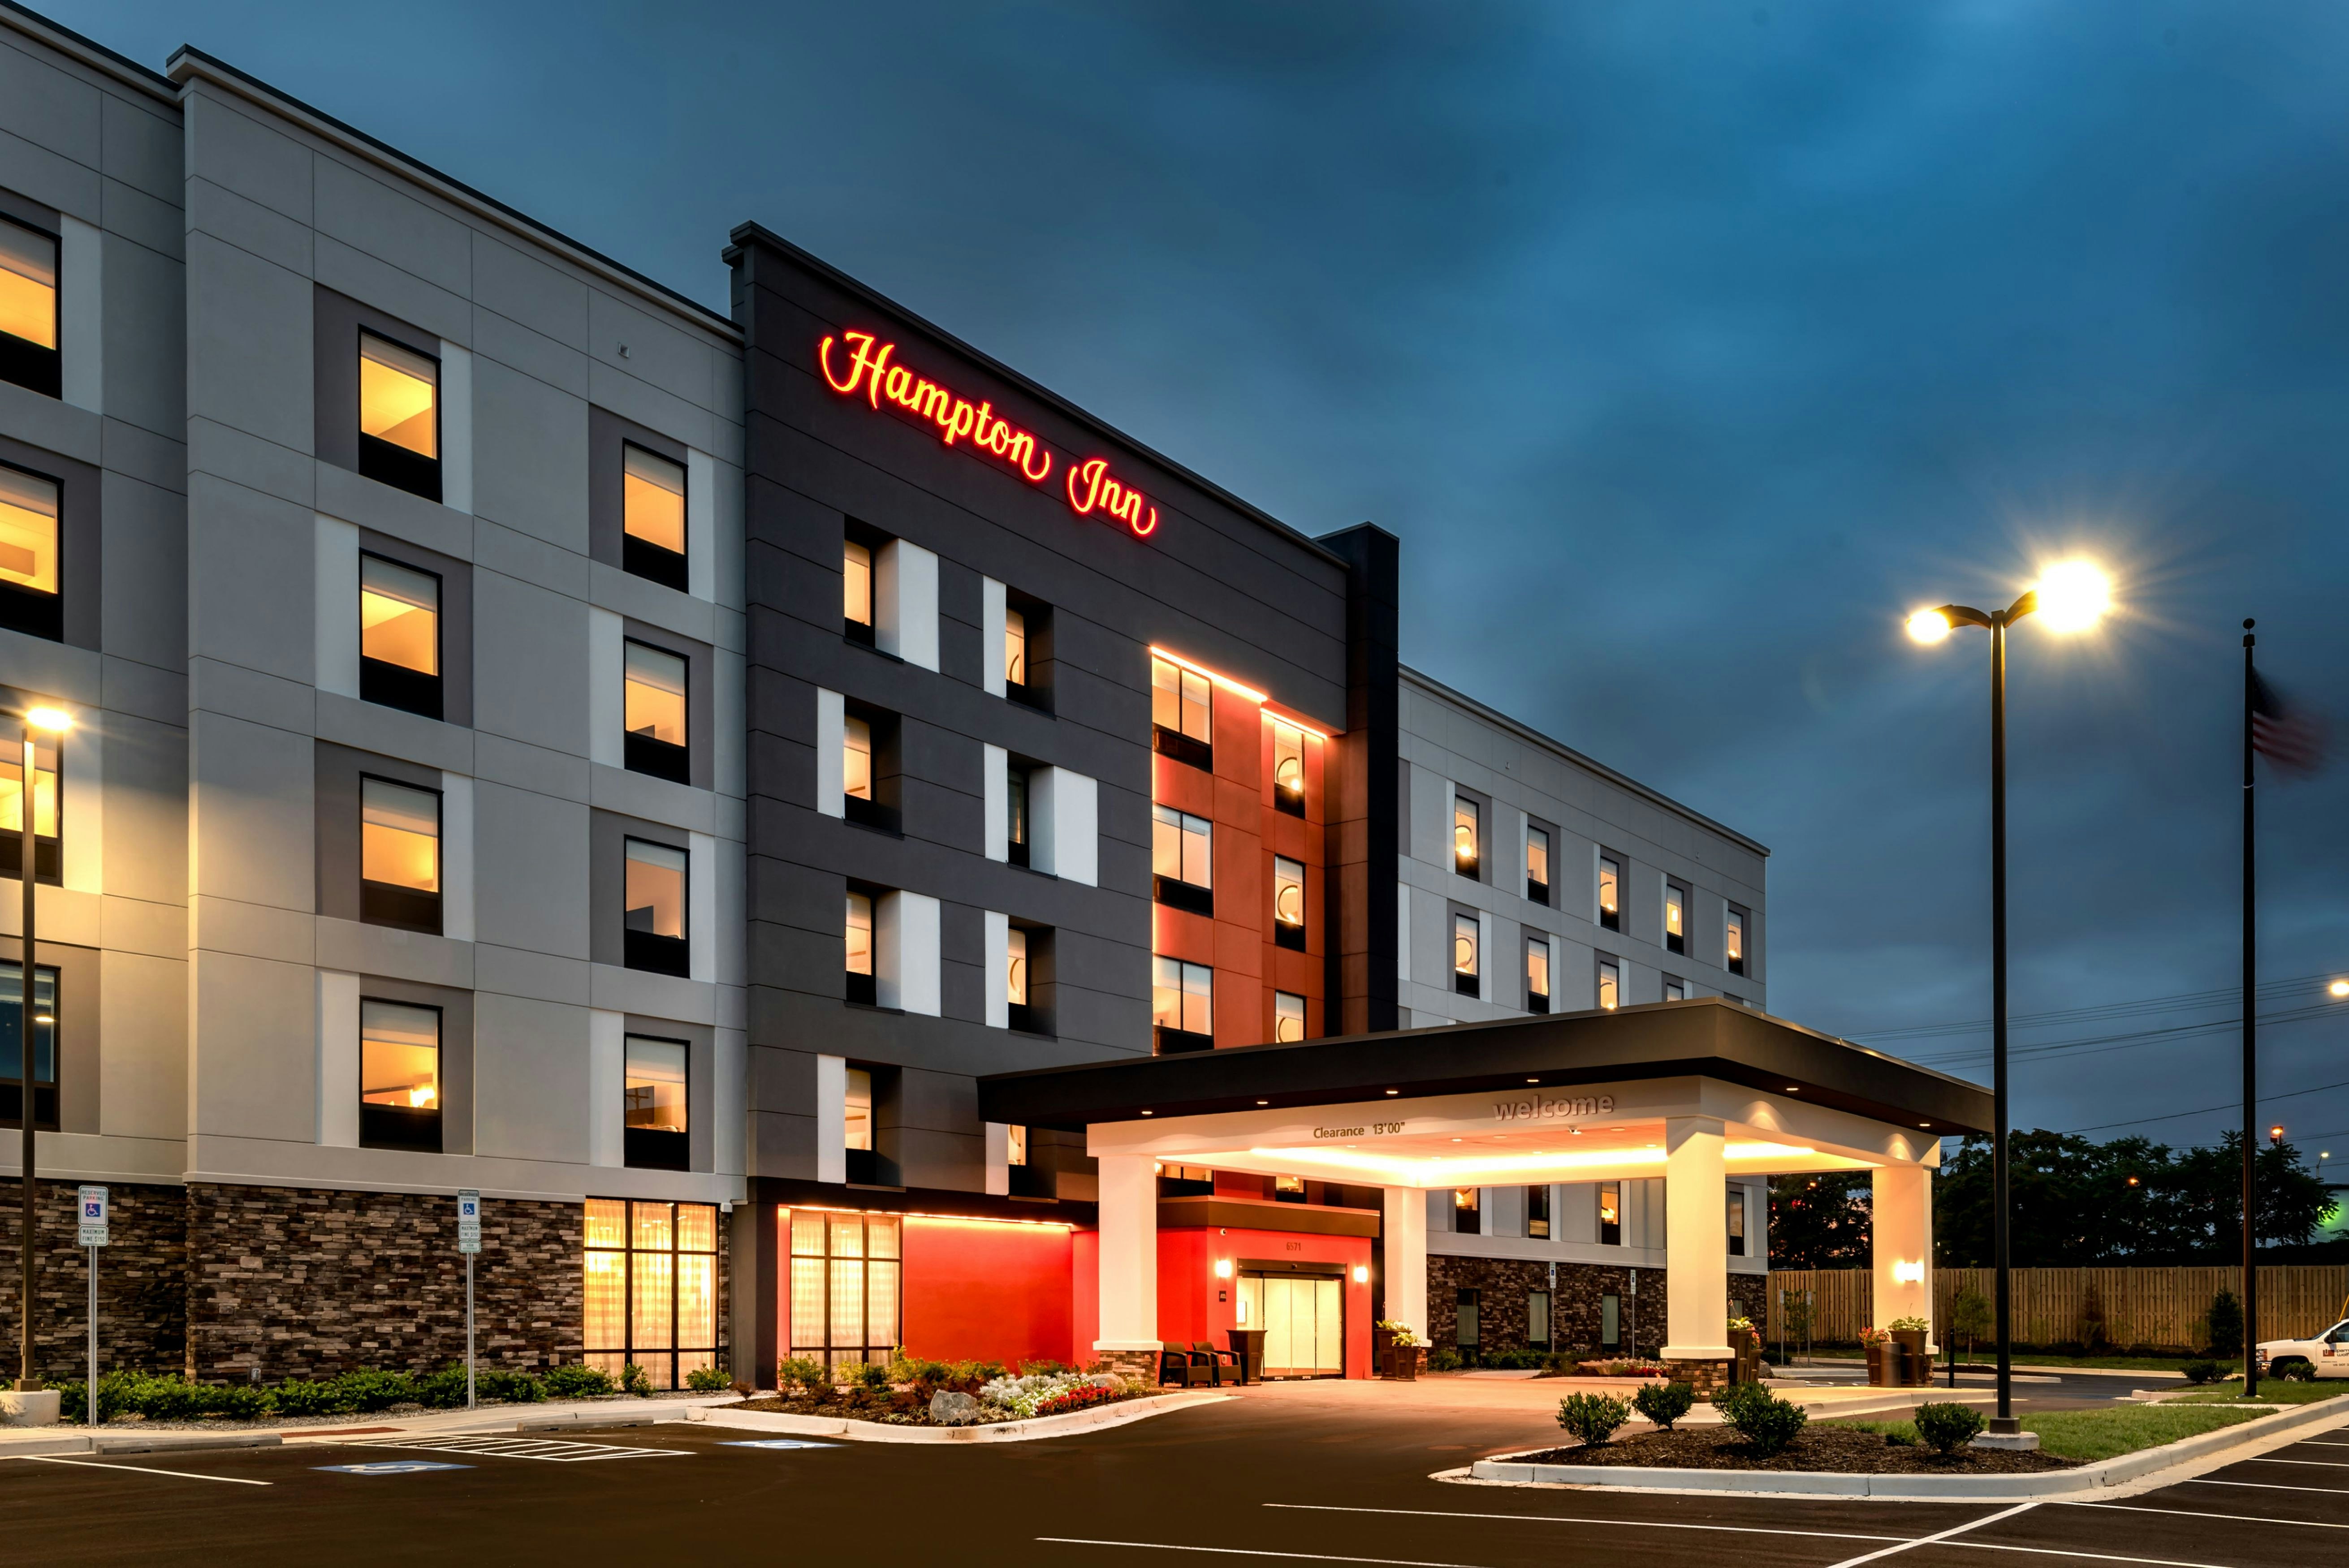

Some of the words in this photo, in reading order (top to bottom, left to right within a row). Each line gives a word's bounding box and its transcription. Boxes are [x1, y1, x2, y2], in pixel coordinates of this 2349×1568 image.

[820, 331, 1051, 482] Hampton
[1067, 458, 1157, 537] Inn
[1492, 1094, 1614, 1121] welcome
[1313, 1125, 1364, 1139] Clearance
[1372, 1121, 1406, 1135] 13'00"
[1286, 1242, 1301, 1251] 6571
